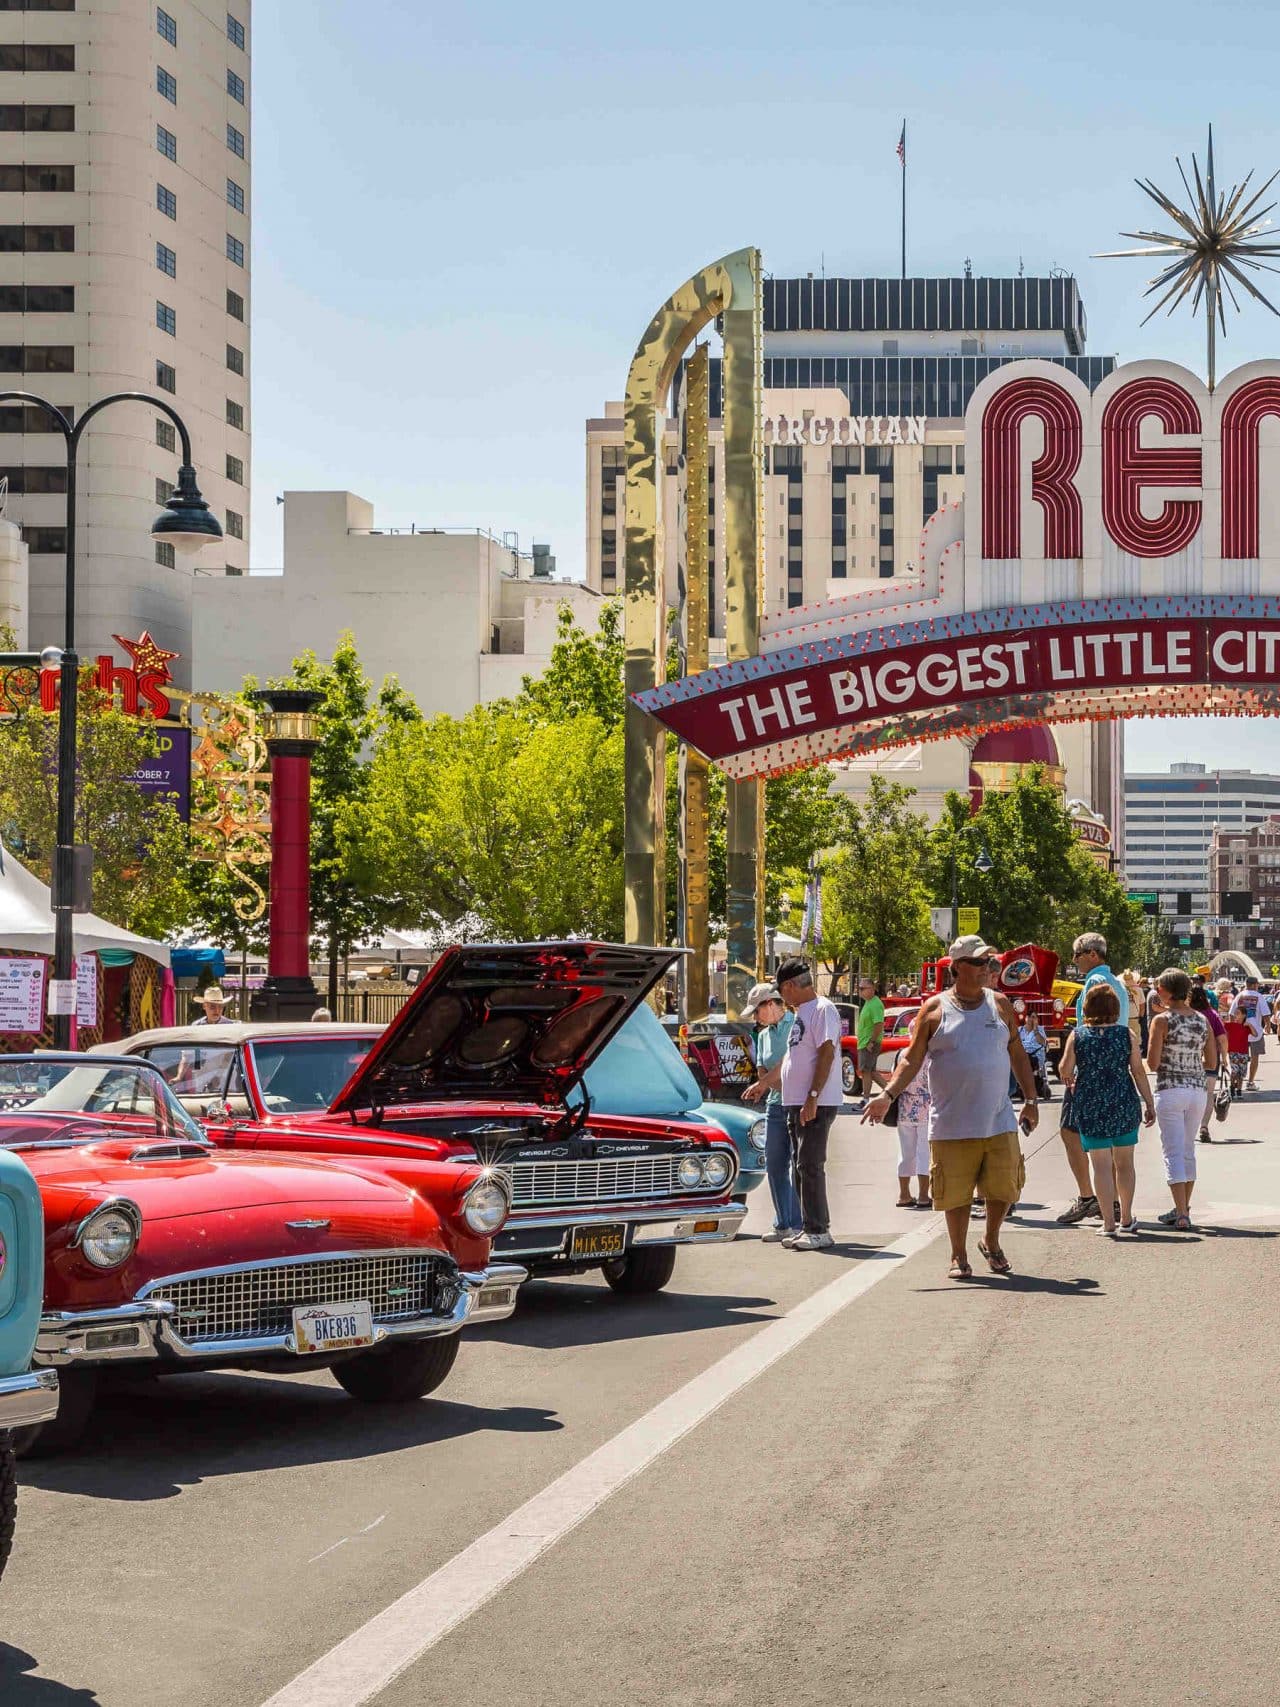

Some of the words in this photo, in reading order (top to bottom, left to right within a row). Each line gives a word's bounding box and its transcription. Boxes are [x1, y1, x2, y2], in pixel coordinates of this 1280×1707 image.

[719, 681, 817, 743] THE
[829, 640, 1031, 715] BIGGEST
[1049, 631, 1191, 680] LITTLE
[164, 770, 170, 779] 7
[601, 1235, 621, 1250] 555
[315, 1316, 357, 1340] BKE836
